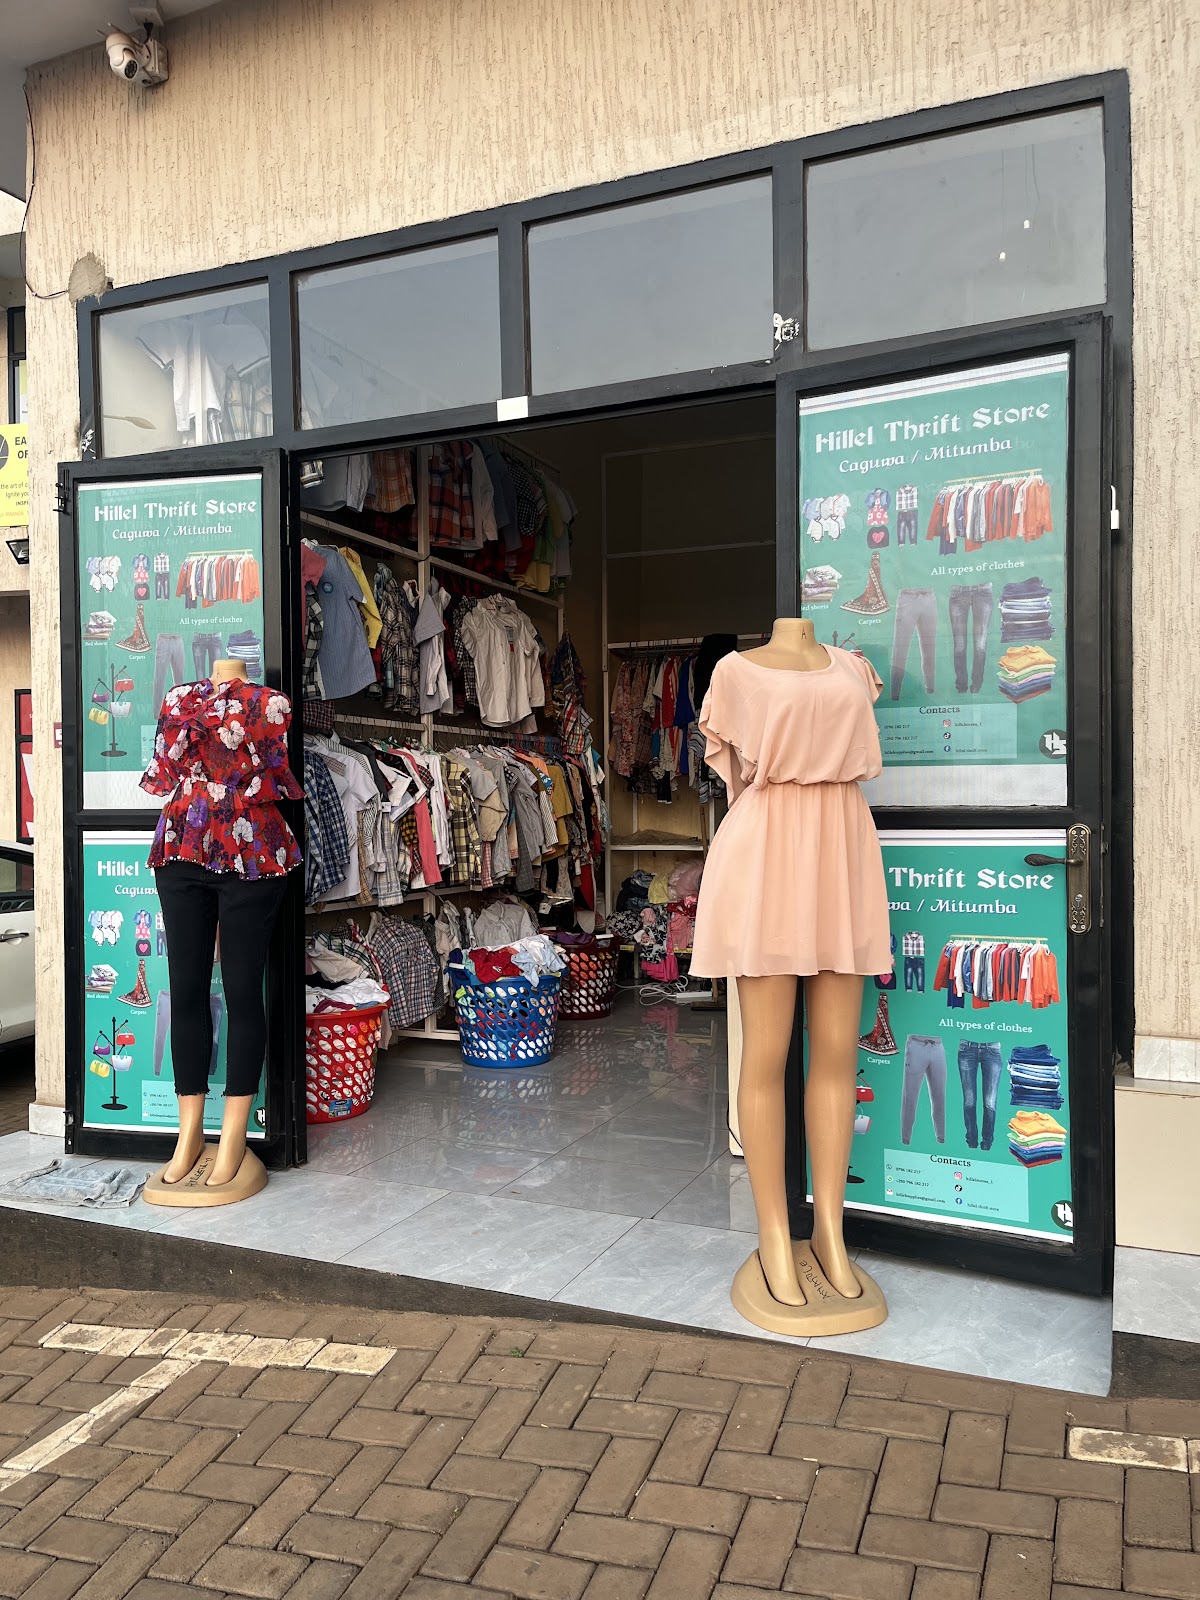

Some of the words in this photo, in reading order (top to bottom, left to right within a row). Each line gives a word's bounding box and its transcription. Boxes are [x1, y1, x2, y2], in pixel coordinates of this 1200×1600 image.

[815, 425, 874, 454] Hillel
[884, 413, 960, 442] Thrift
[972, 402, 1052, 430] Store
[15, 436, 28, 445] EA
[839, 454, 905, 475] Caguwa
[911, 449, 919, 464] /
[924, 437, 1012, 461] Mitumba
[94, 504, 137, 521] Hillel
[144, 501, 197, 518] Thrift
[205, 499, 257, 515] Store
[112, 529, 160, 542] Caguwa
[173, 523, 232, 536] Mitumba
[930, 566, 946, 576] All
[948, 564, 974, 577] types
[975, 562, 988, 572] of
[988, 560, 1025, 570] clothes
[191, 618, 208, 626] types
[210, 616, 218, 624] of
[218, 616, 242, 624] clothes
[858, 618, 882, 626] Carpets
[919, 706, 961, 715] Contacts
[97, 860, 139, 876] Hillel
[888, 867, 966, 890] Thrift
[977, 868, 1055, 890] Store
[930, 899, 1018, 914] Mitumba
[939, 1018, 954, 1028] All
[956, 1020, 982, 1031] types
[984, 1021, 995, 1031] of
[997, 1023, 1033, 1034] clothes
[867, 1057, 890, 1066] Carpets
[930, 1154, 971, 1168] Contacts
